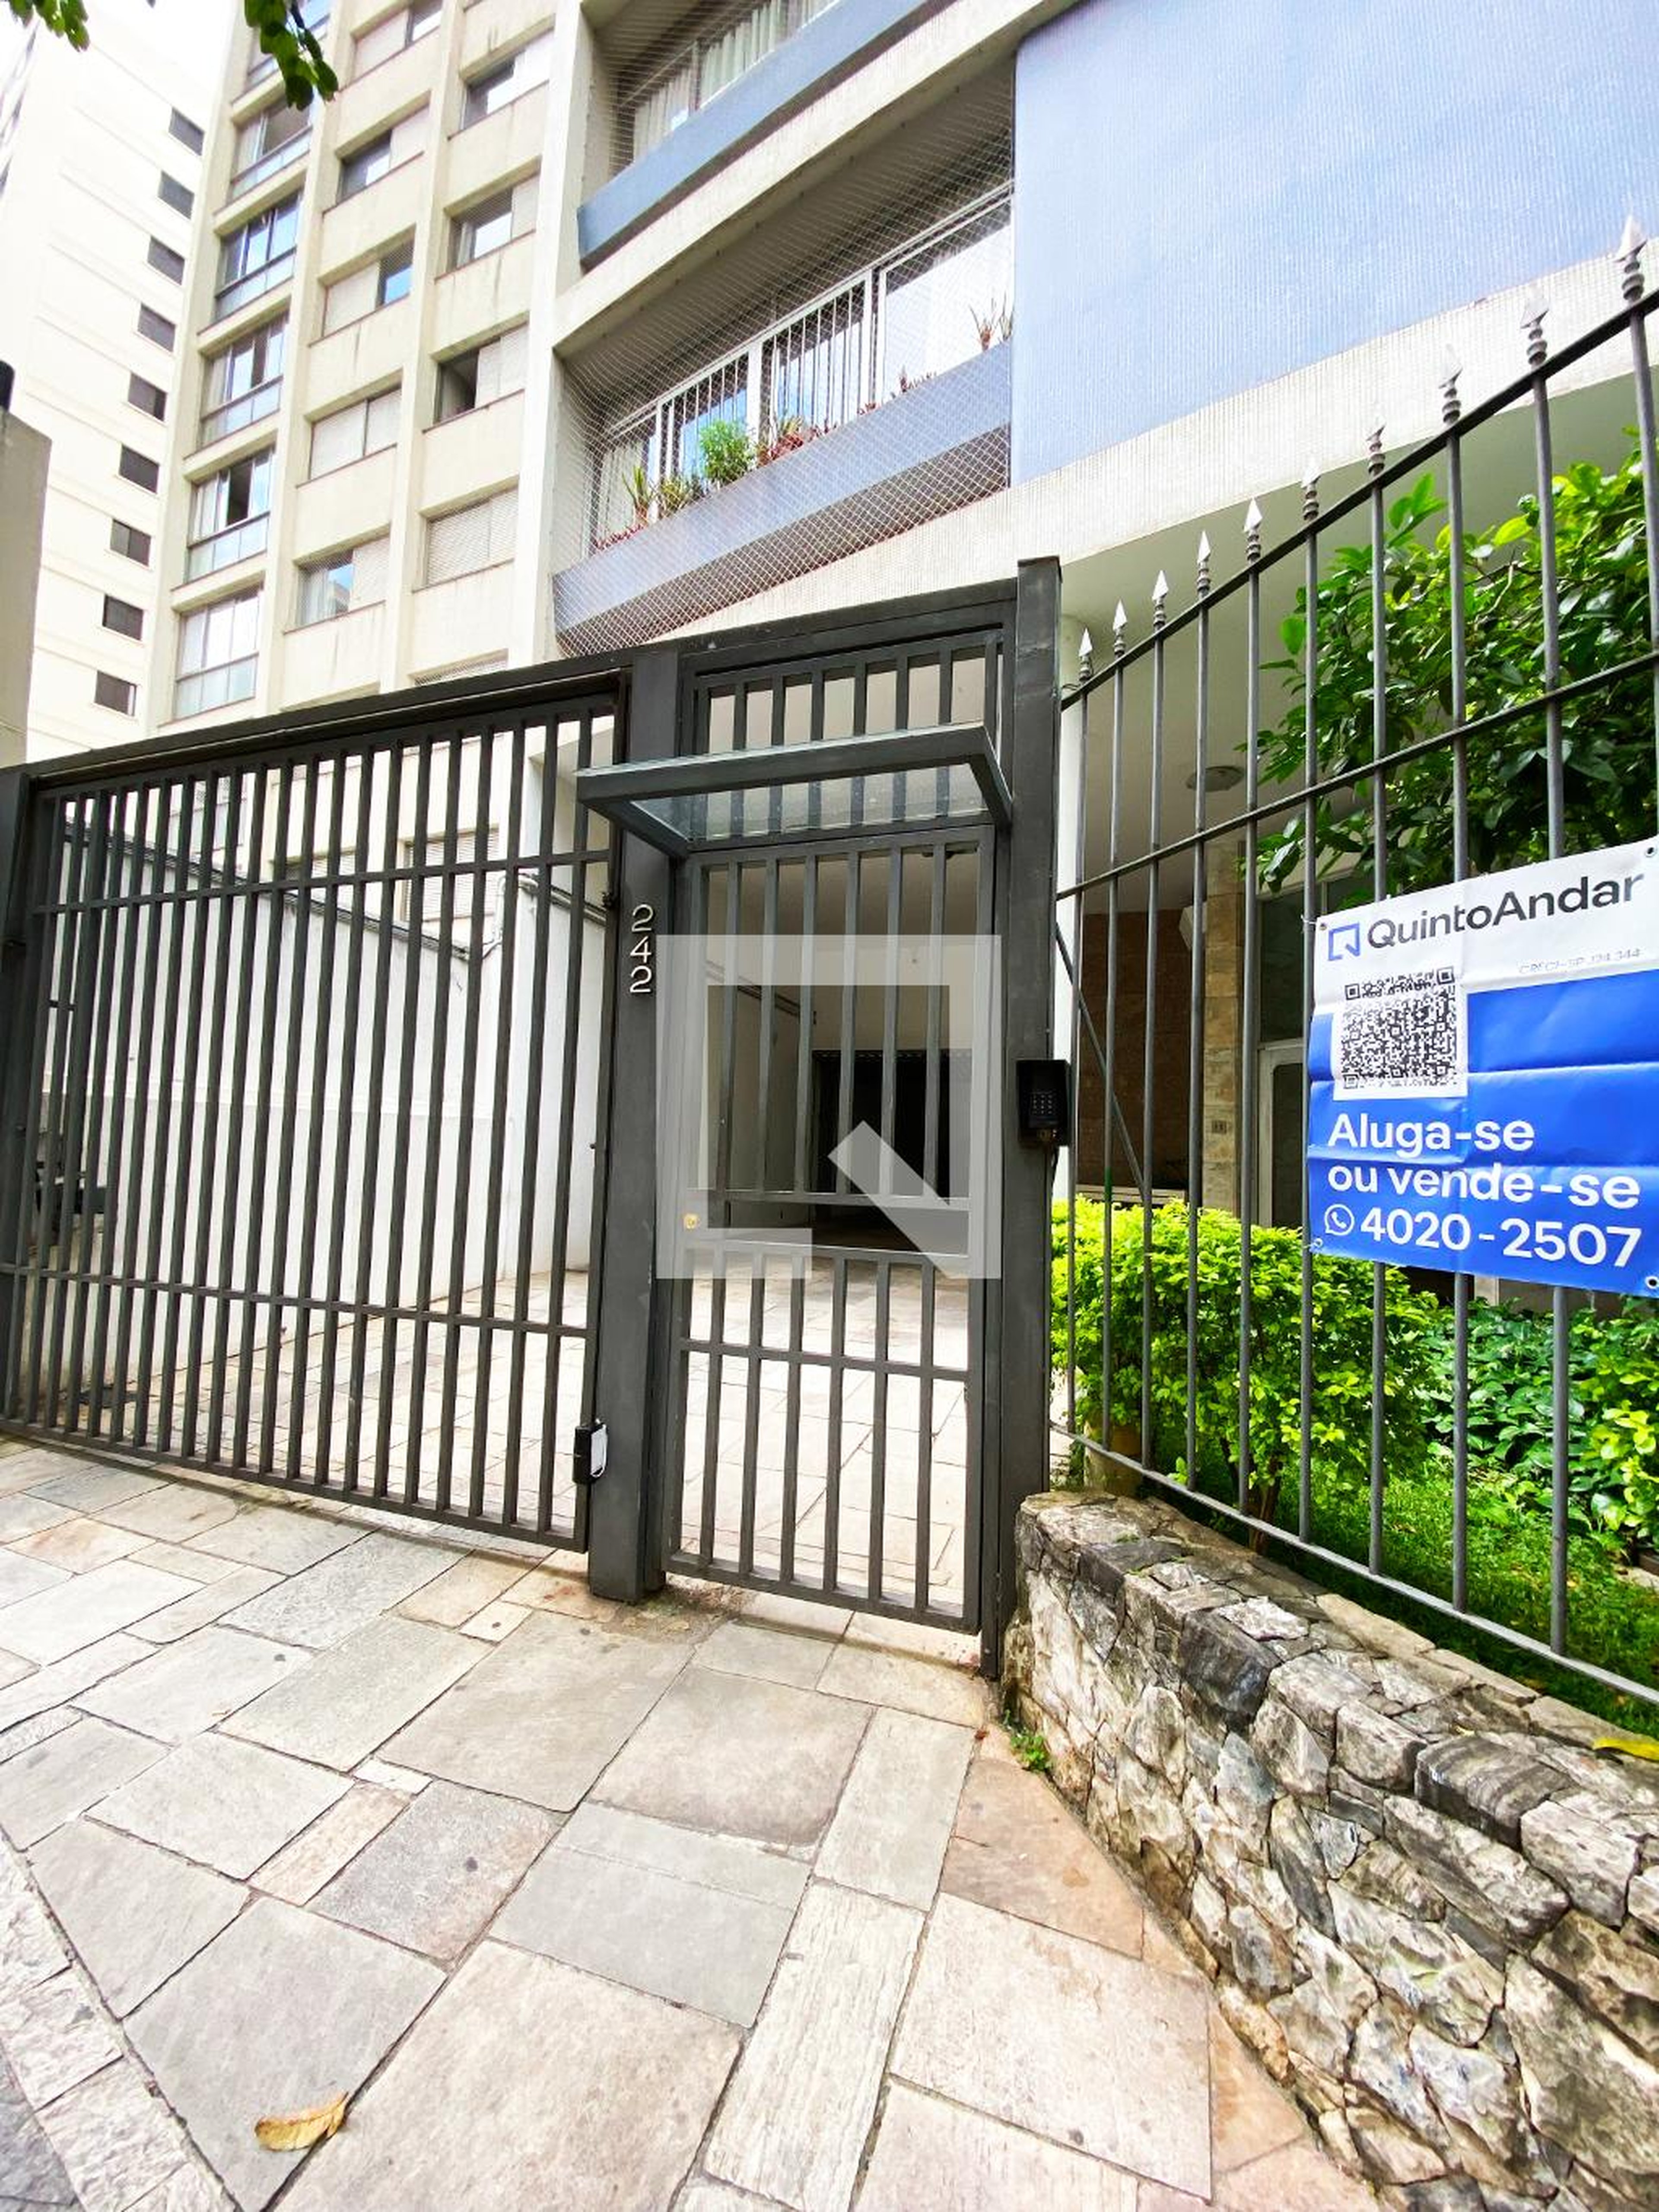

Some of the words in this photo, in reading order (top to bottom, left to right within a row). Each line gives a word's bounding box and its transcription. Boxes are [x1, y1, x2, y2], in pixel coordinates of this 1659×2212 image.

[1367, 873, 1644, 949] QuintoAndar
[630, 904, 654, 993] 242
[1328, 1113, 1535, 1158] Aluga-se
[1328, 1165, 1377, 1194] ou
[1386, 1162, 1640, 1209] vende-se
[1360, 1207, 1642, 1269] 4020-2507
